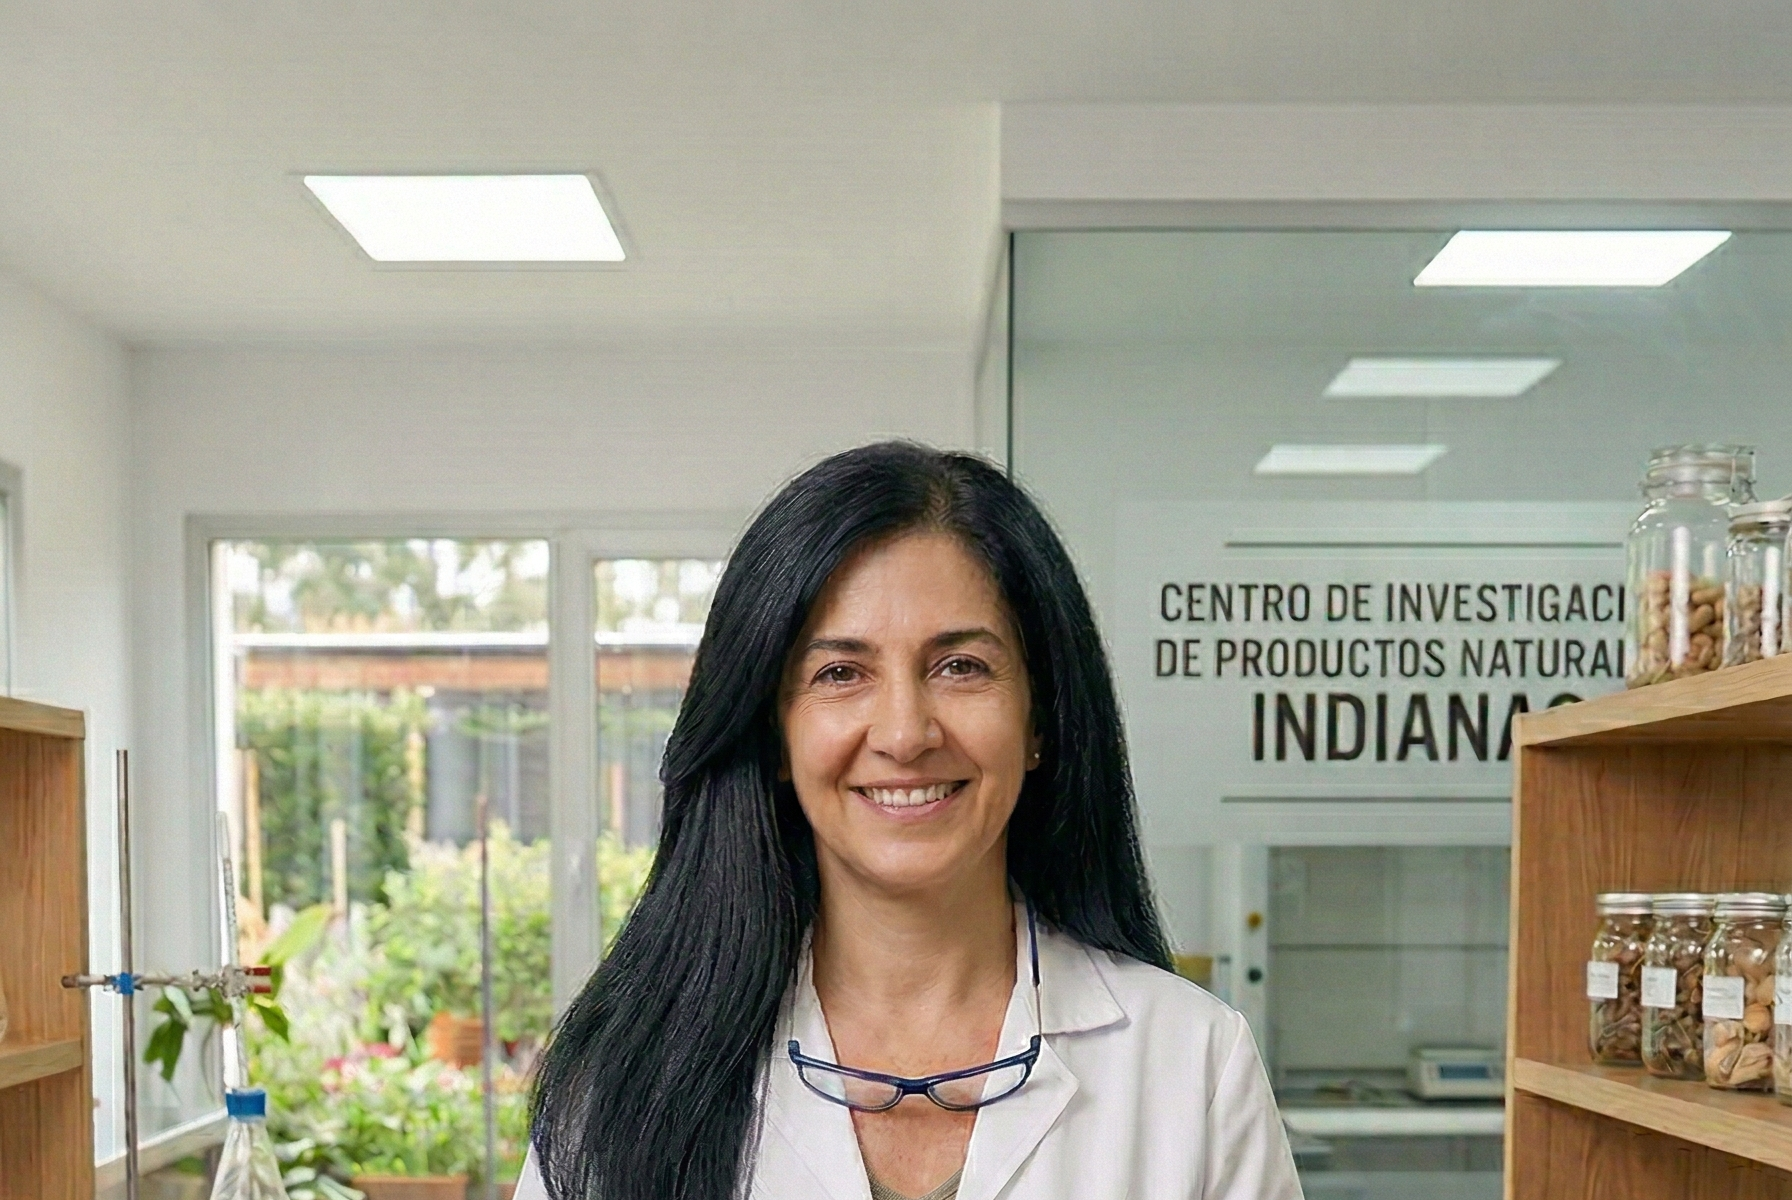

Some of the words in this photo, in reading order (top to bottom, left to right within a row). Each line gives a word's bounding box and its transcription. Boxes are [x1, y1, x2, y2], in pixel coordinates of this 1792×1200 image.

[1160, 583, 1311, 623] CENTRO
[1327, 583, 1372, 623] DE
[1386, 583, 1626, 623] INVESTIGACI
[1156, 638, 1202, 678] DE
[1216, 638, 1446, 679] PRODUCTOS
[1253, 692, 1586, 763] INDIANA
